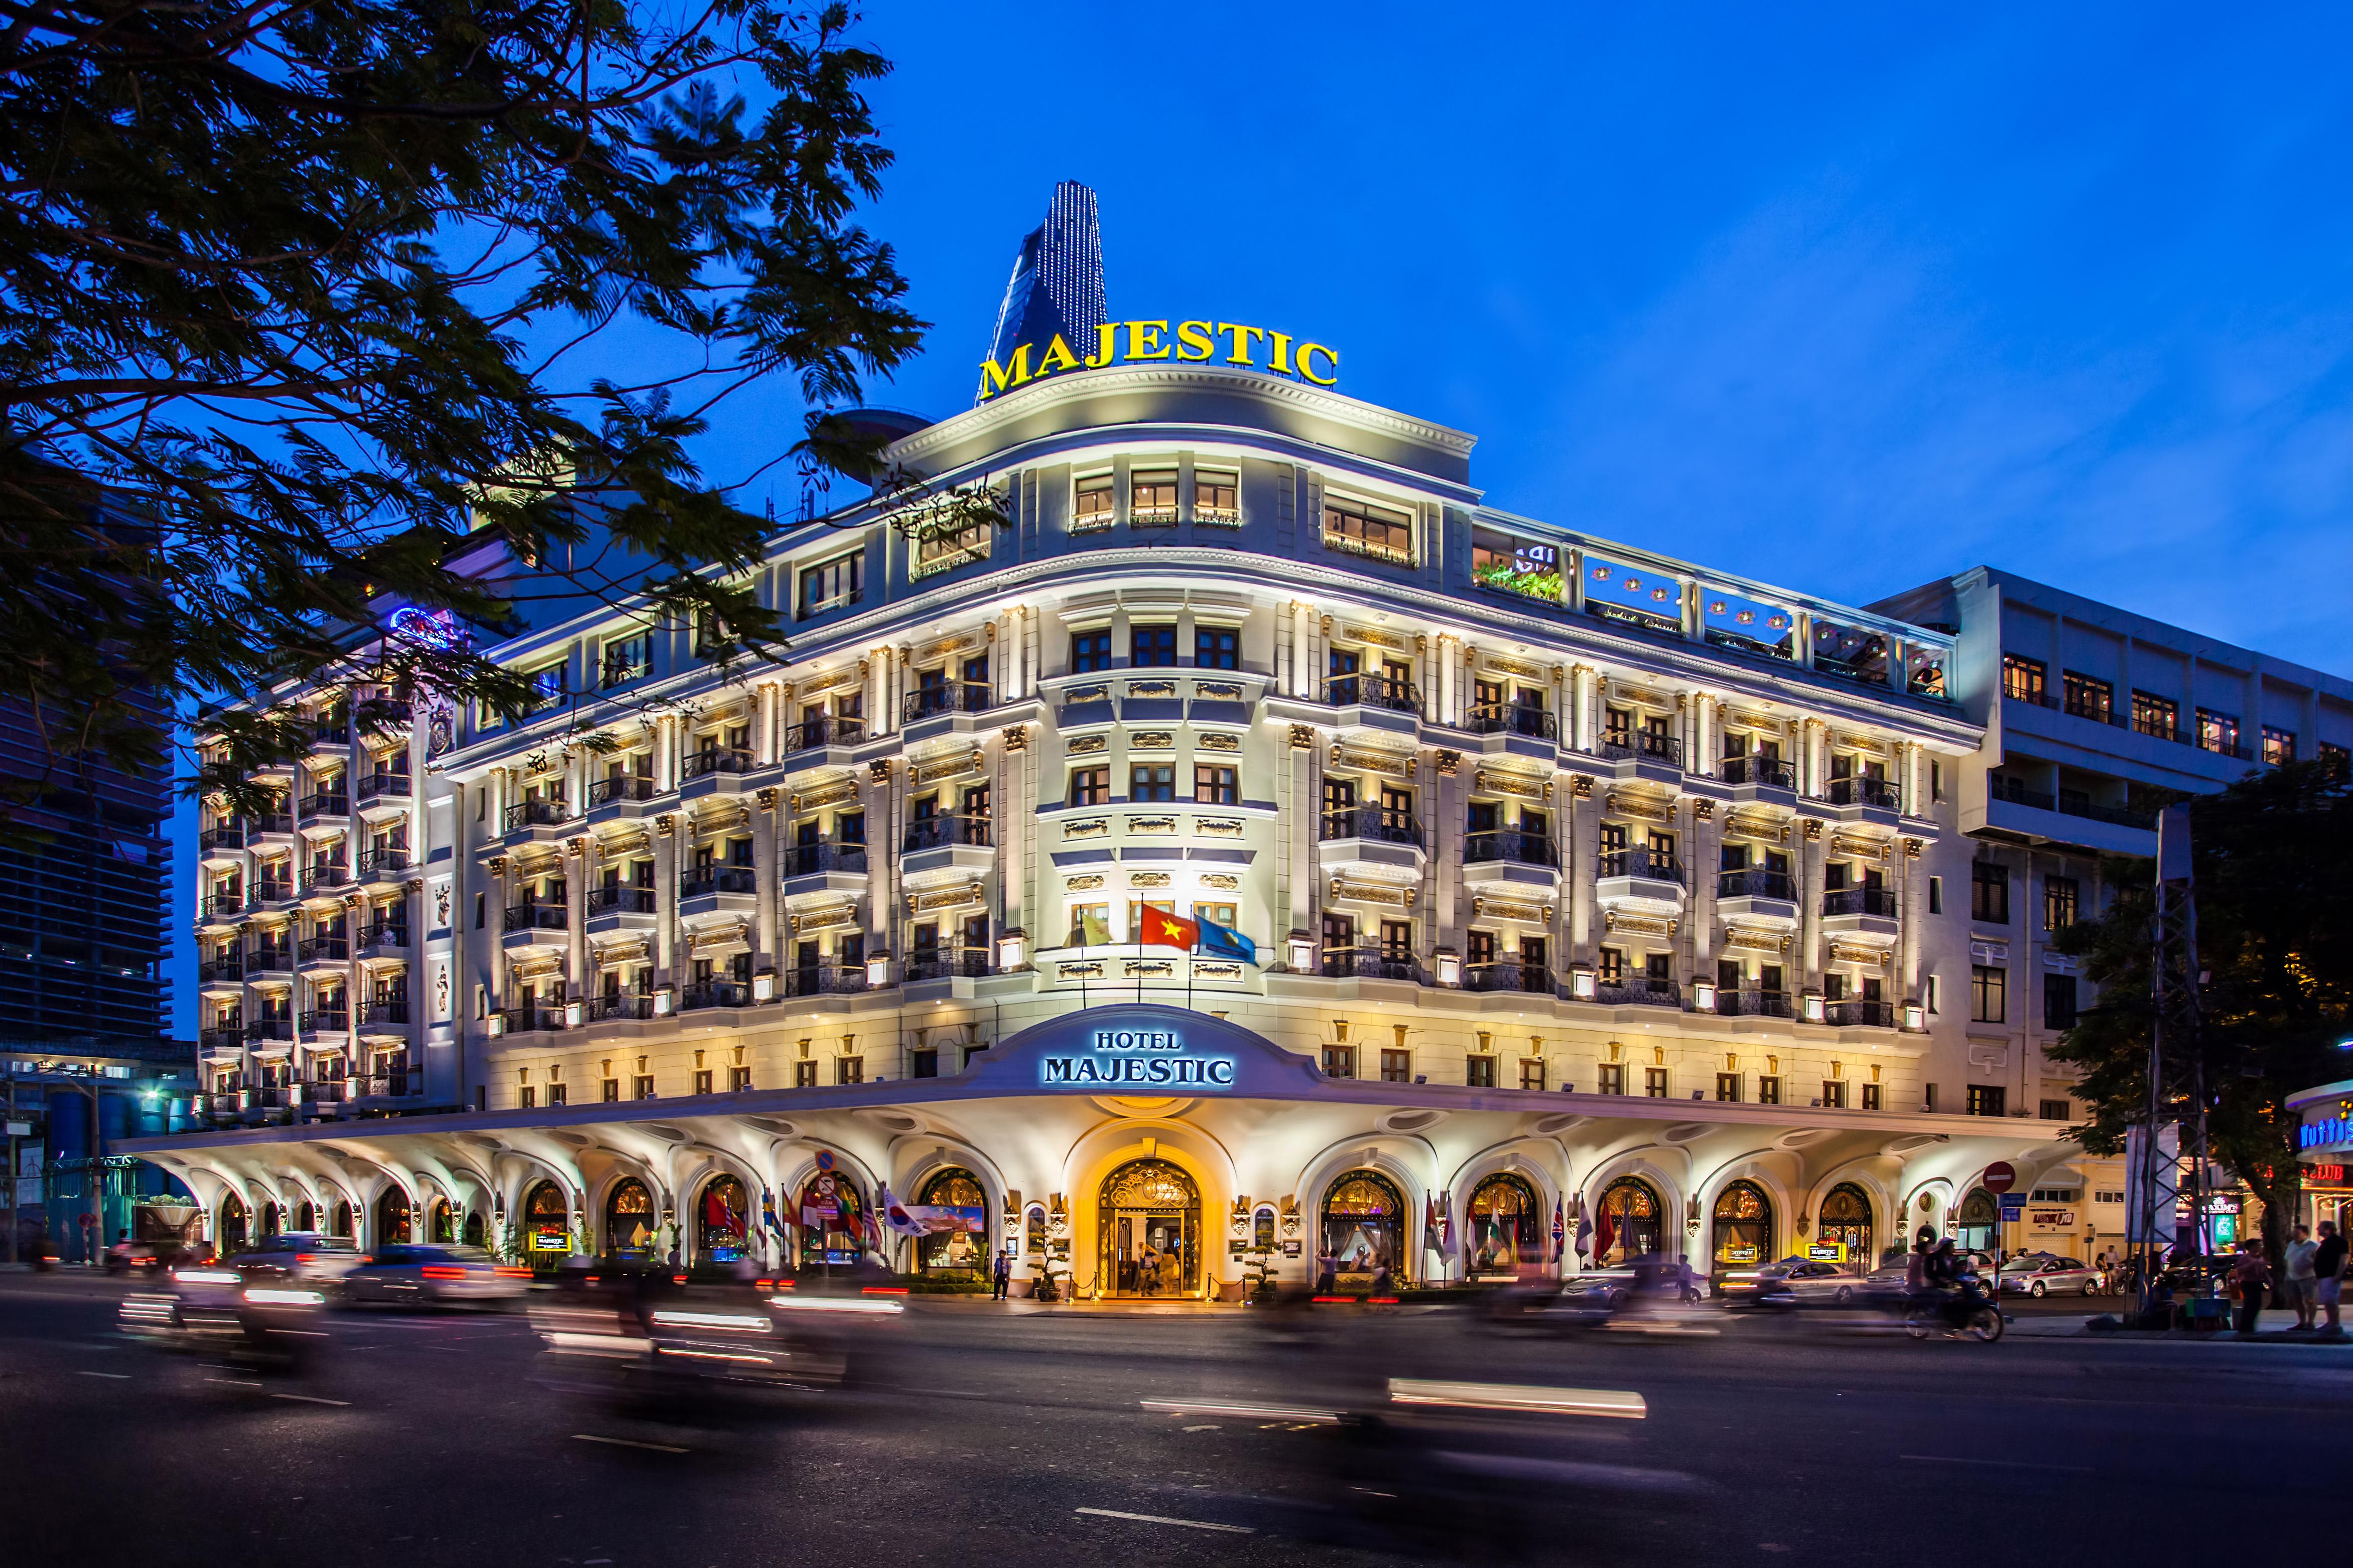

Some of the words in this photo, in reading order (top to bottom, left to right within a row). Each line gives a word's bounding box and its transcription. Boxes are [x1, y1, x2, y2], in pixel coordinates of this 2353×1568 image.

[979, 320, 1338, 400] MAJESTIC
[1096, 1033, 1182, 1049] HOTEL
[1044, 1058, 1233, 1084] MAJESTIC
